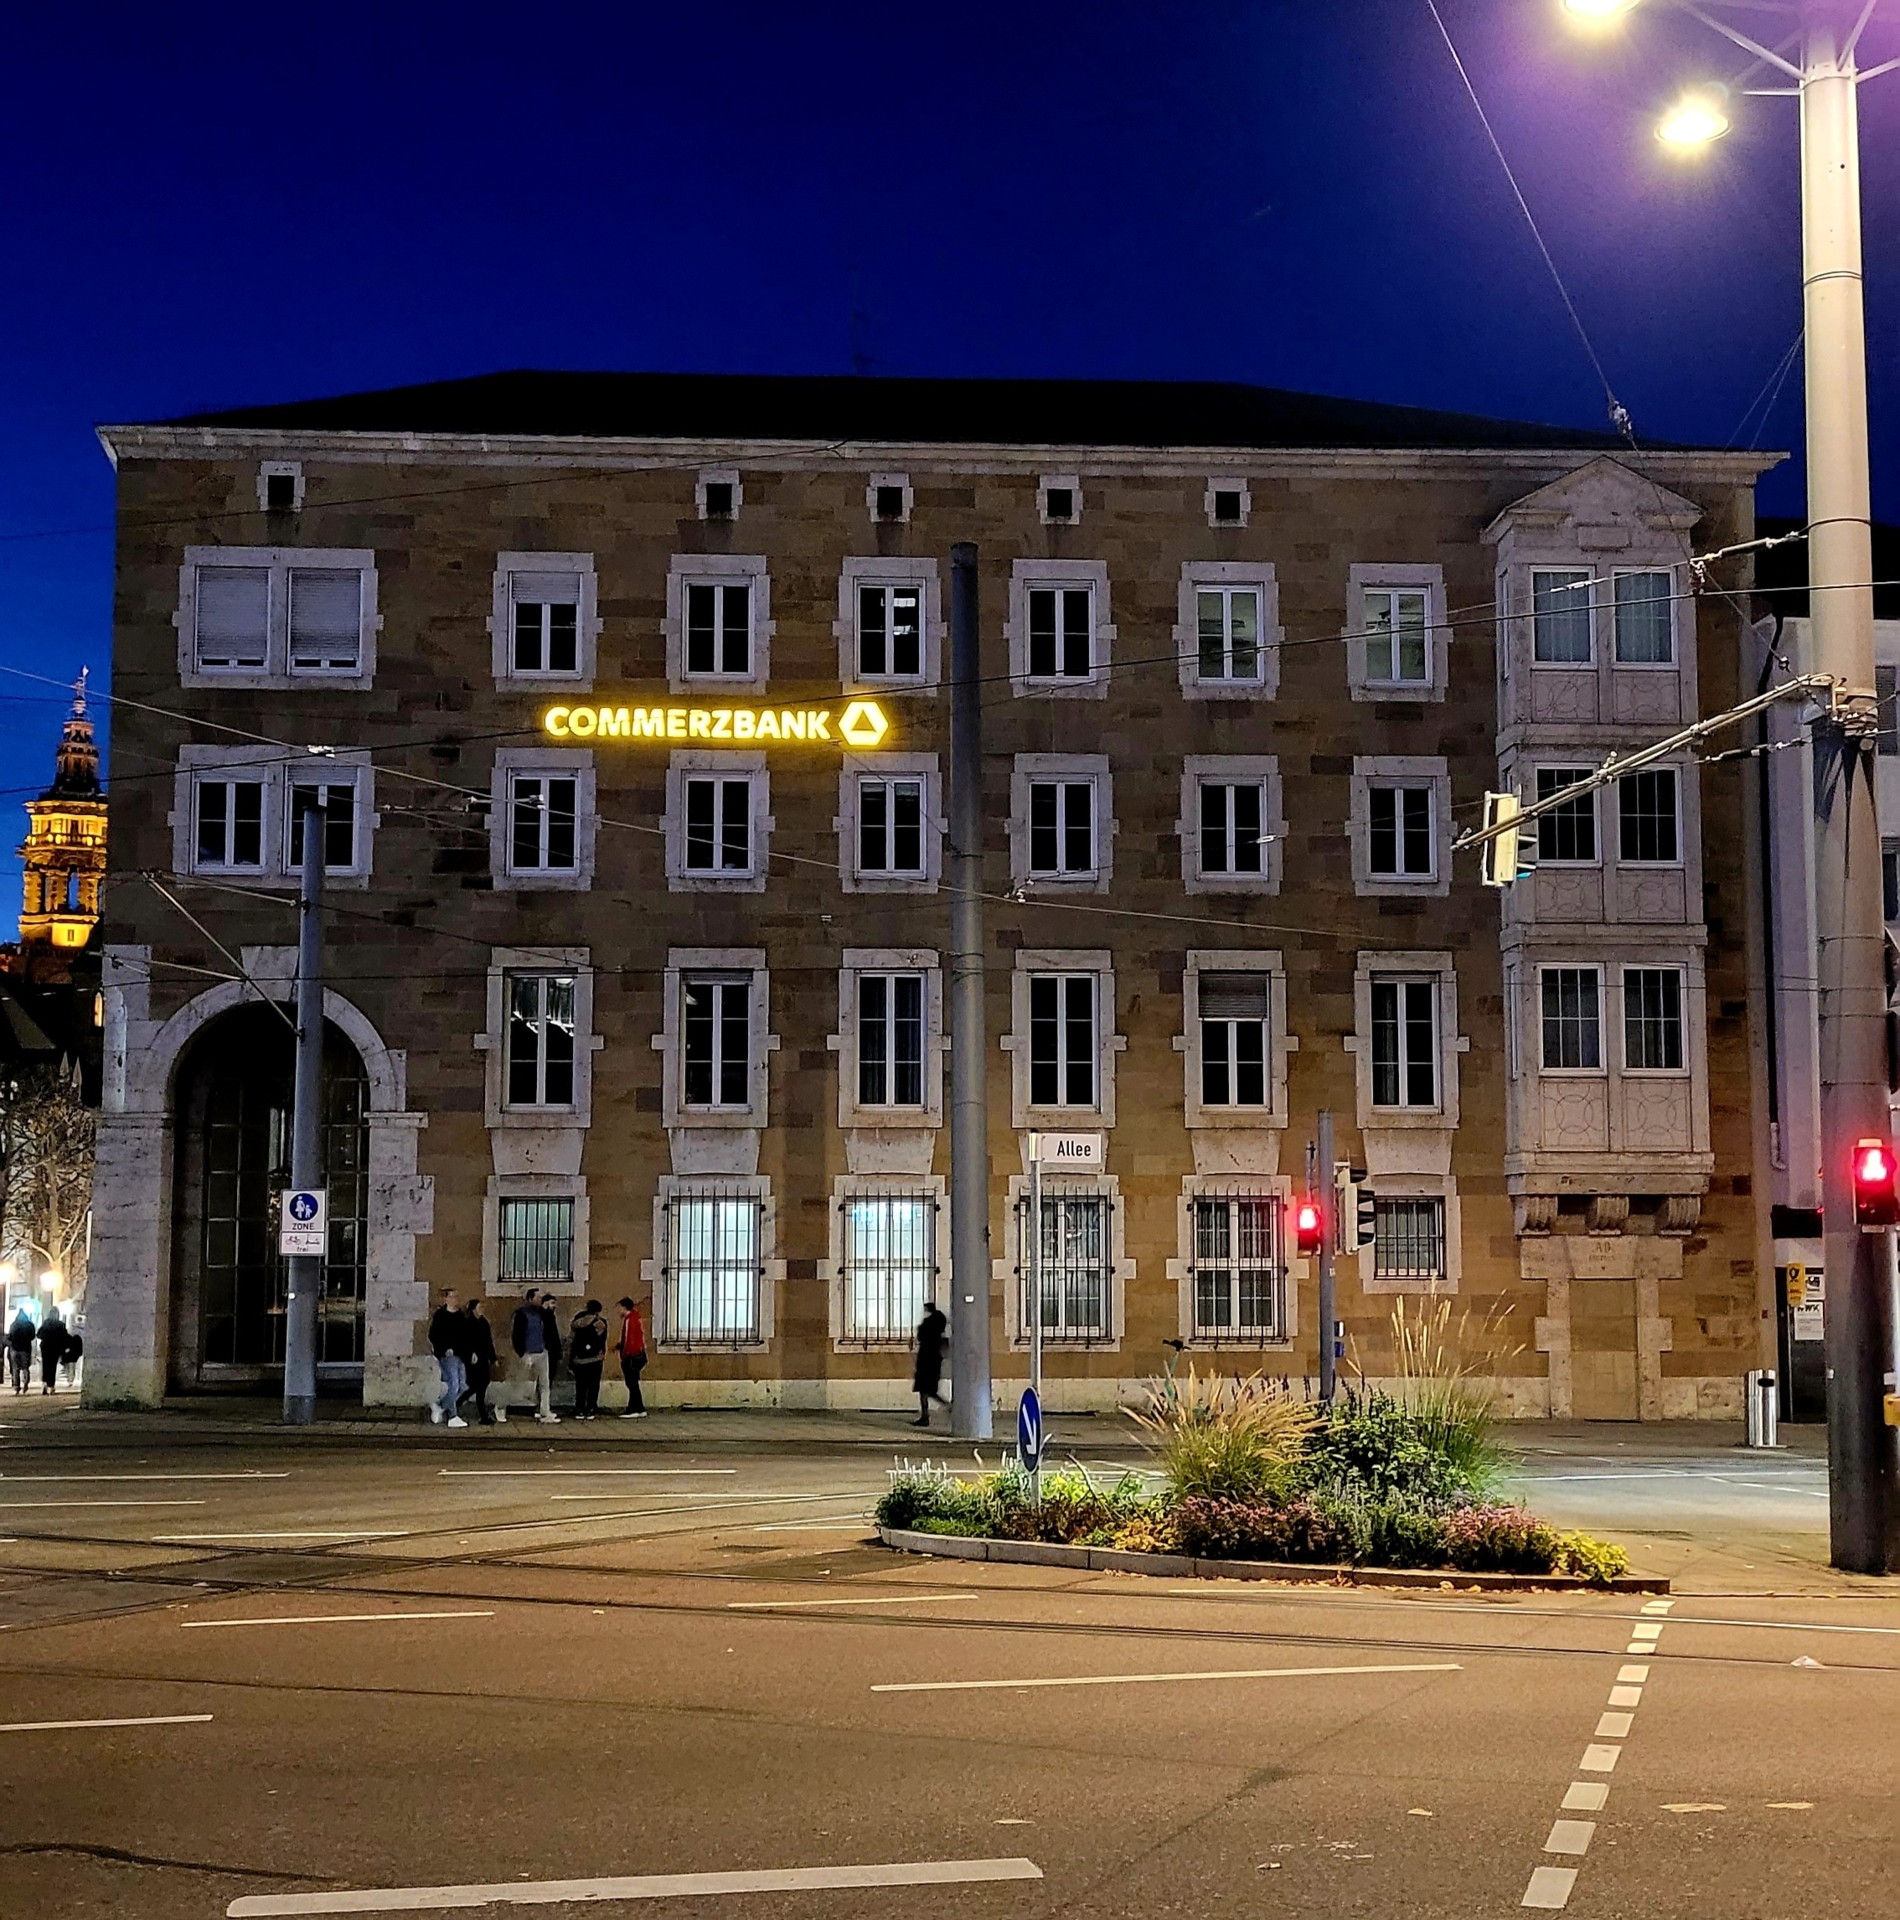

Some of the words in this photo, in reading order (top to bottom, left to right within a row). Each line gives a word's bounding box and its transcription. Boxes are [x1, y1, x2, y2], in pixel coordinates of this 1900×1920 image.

[545, 705, 831, 740] COMMERZBANK
[1056, 1140, 1092, 1157] Allee
[291, 1222, 315, 1231] ZONE
